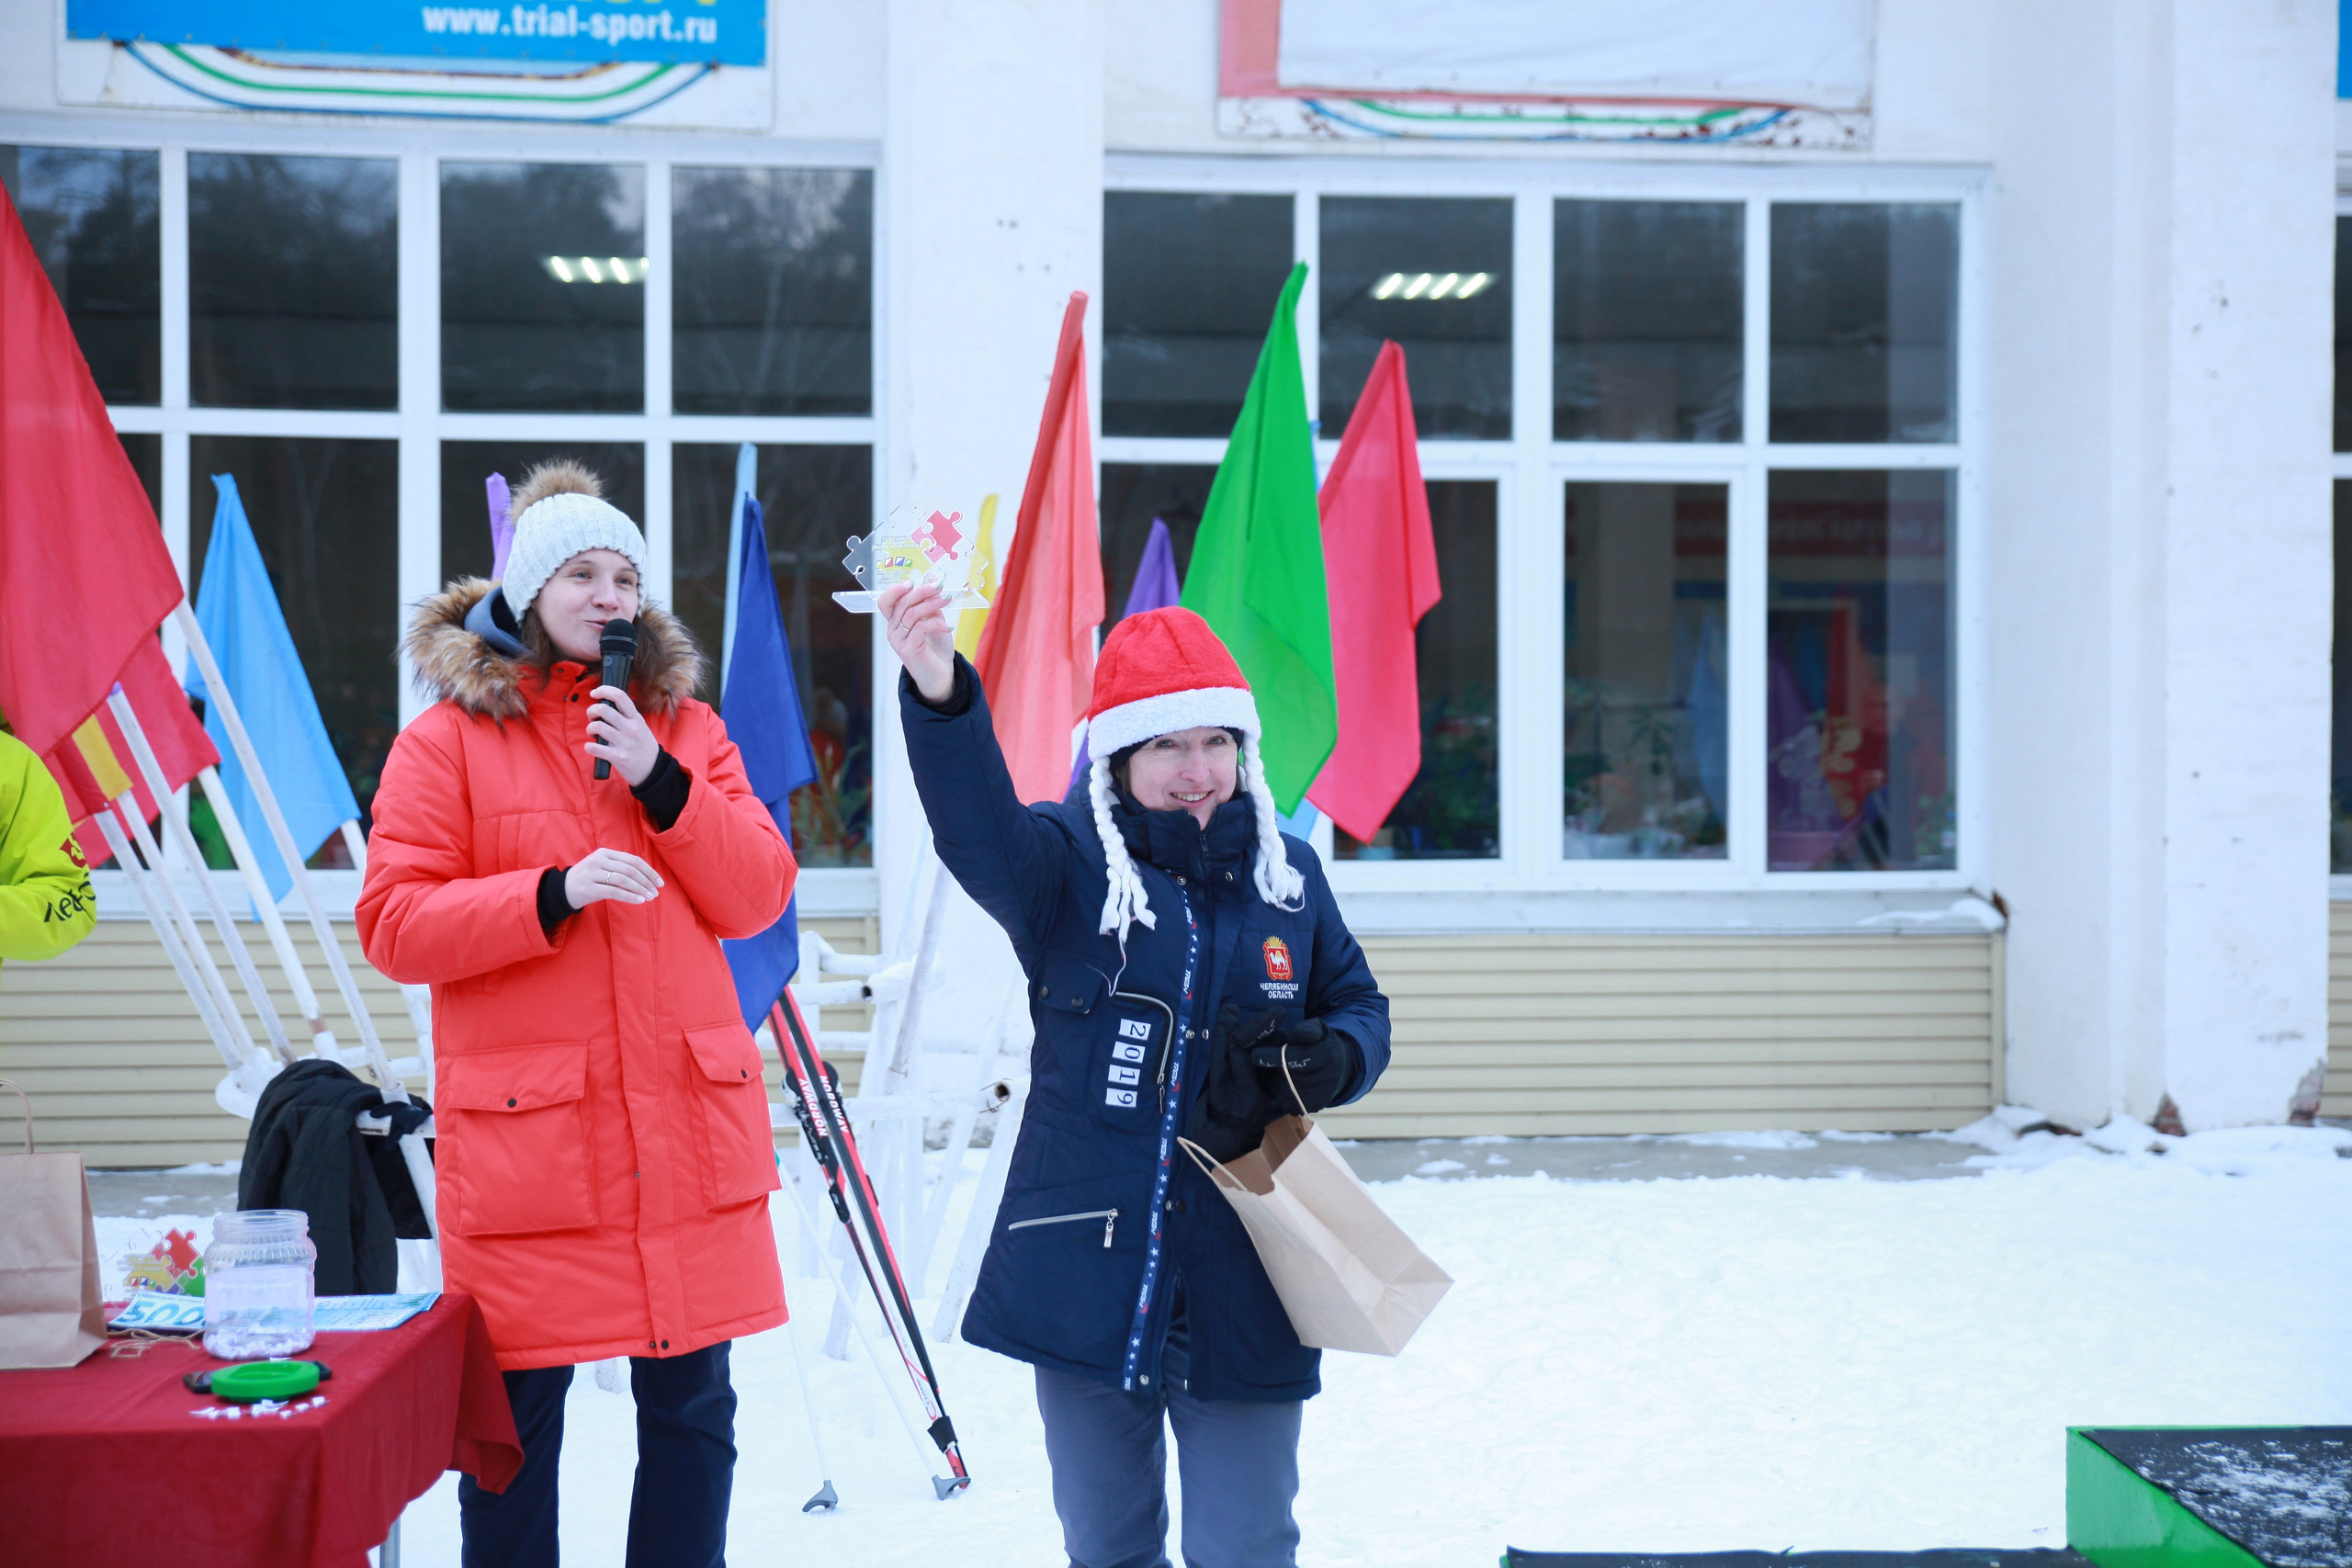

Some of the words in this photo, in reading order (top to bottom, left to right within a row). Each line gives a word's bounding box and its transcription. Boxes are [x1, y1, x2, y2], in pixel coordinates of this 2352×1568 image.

[421, 4, 718, 46] www.trial-sport.ru
[1268, 990, 1295, 999] ОБЛАСТЬ
[798, 1077, 829, 1137] NORDWAY
[819, 1075, 850, 1134] NORDWAY
